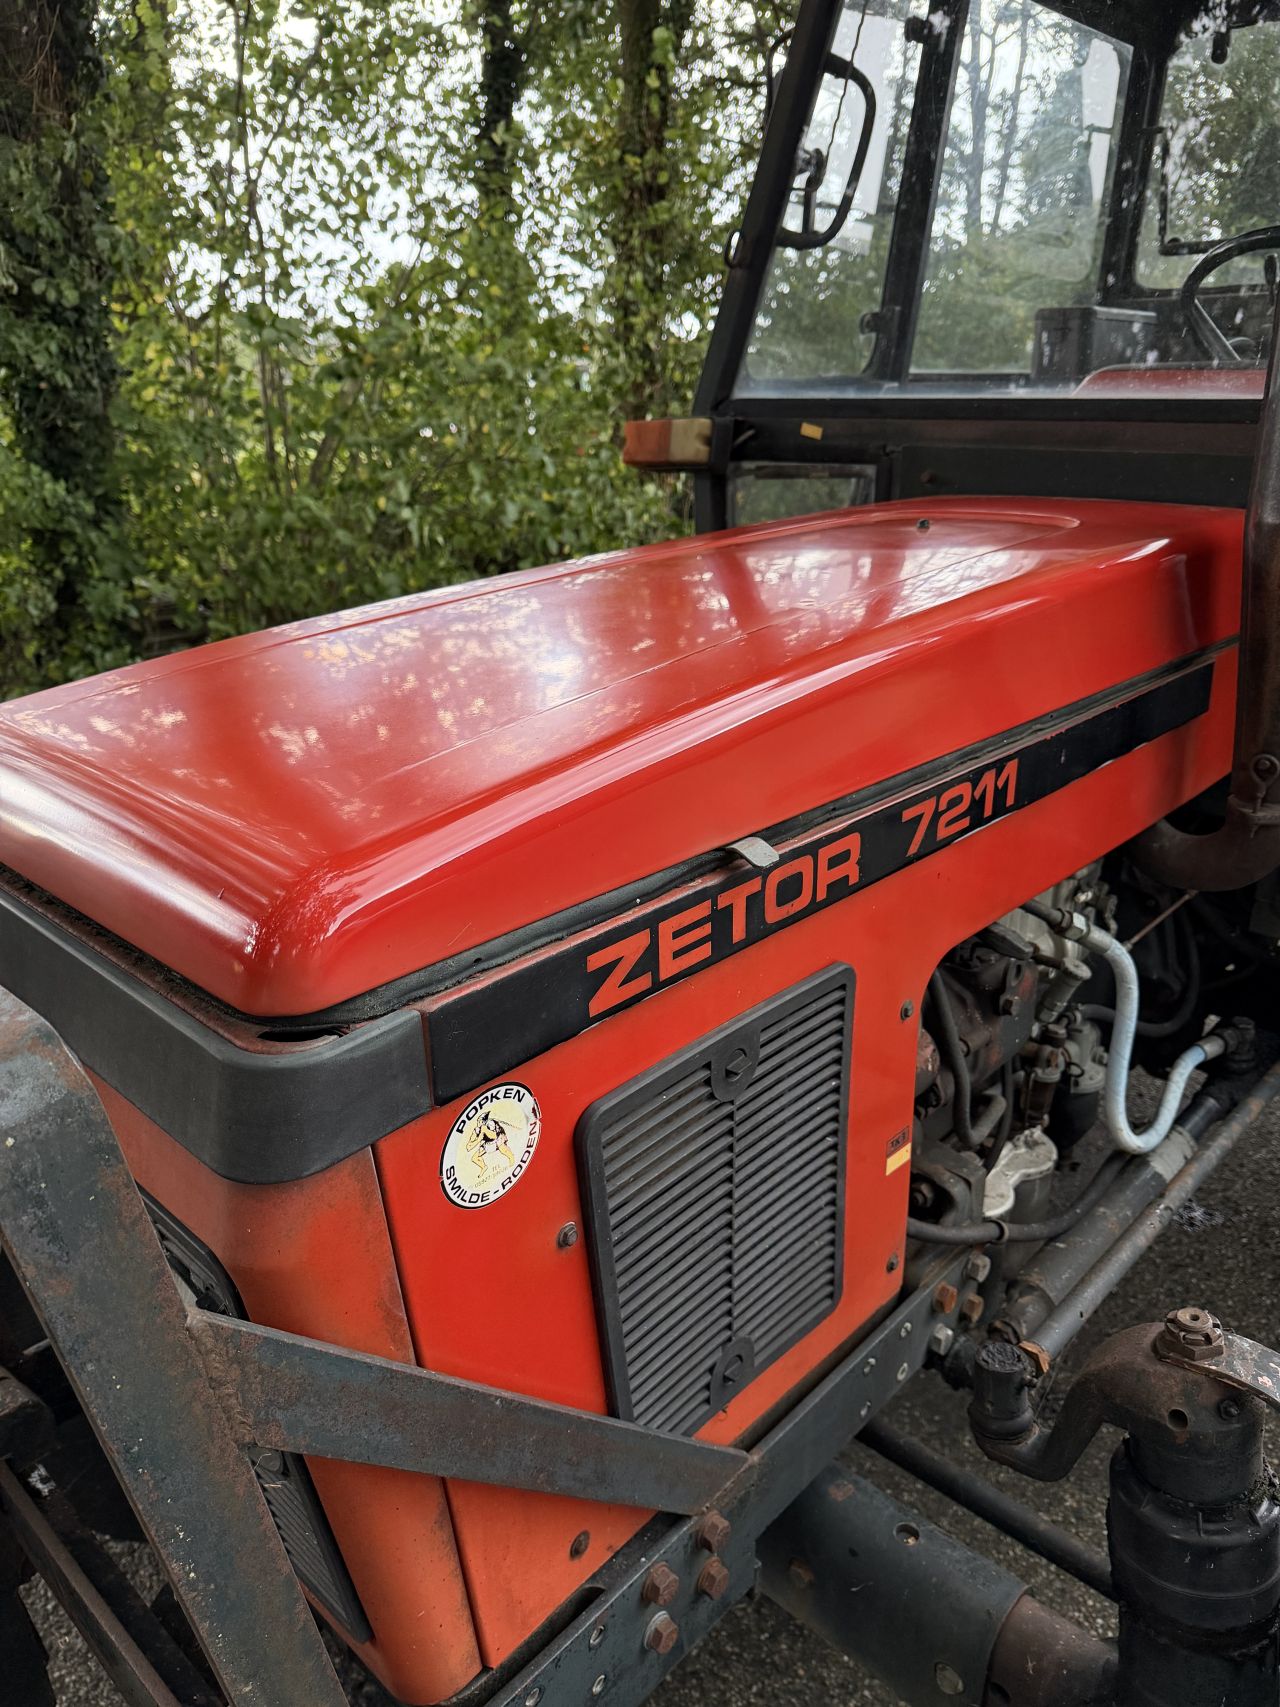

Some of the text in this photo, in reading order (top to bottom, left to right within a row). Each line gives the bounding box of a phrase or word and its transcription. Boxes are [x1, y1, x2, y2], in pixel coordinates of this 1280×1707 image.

[586, 758, 1019, 1018] ZETOR 7211
[455, 1088, 525, 1134] POPKEN
